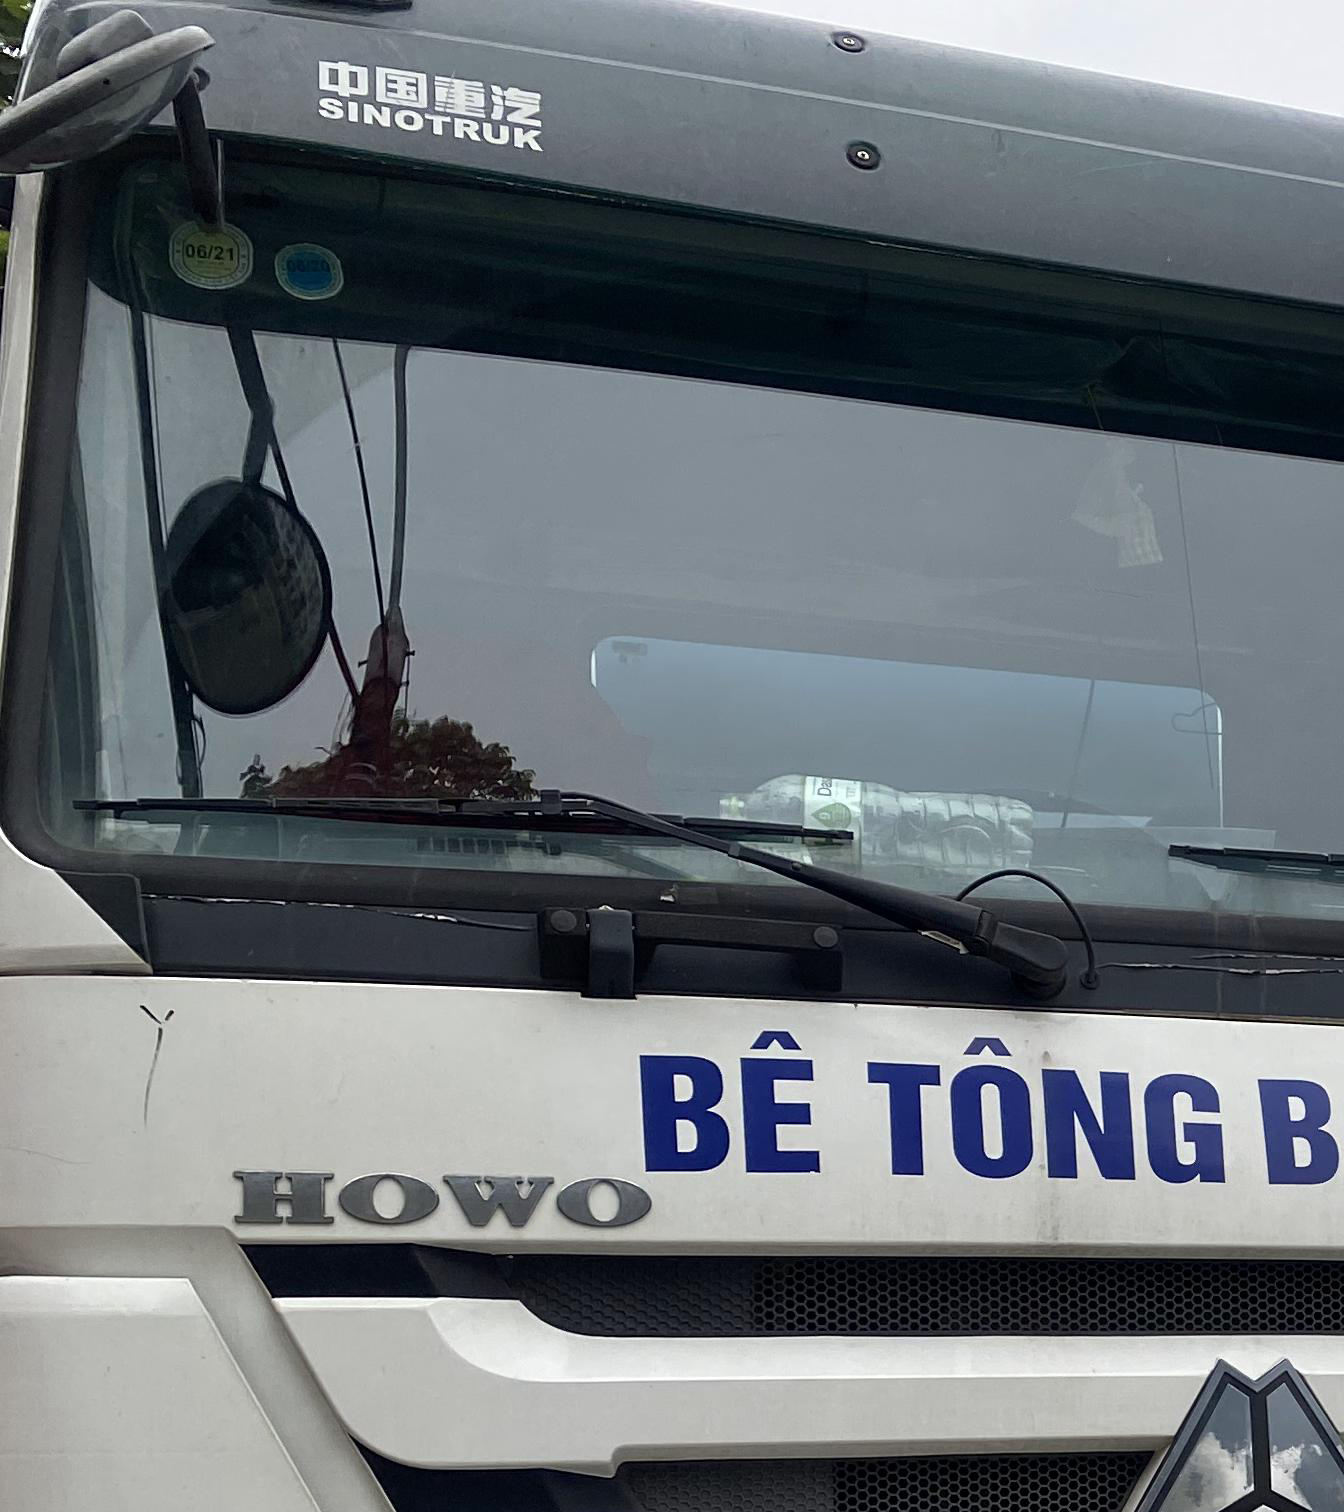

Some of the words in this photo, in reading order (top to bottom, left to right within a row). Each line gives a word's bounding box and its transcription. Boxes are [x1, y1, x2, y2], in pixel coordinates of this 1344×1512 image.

[318, 60, 542, 127] 中国重汽
[318, 97, 543, 152] SINOTRUK
[185, 244, 234, 261] 06/21
[640, 1031, 820, 1173] BÊ
[867, 1037, 1226, 1183] TÔNG
[233, 1170, 652, 1227] HOWO
